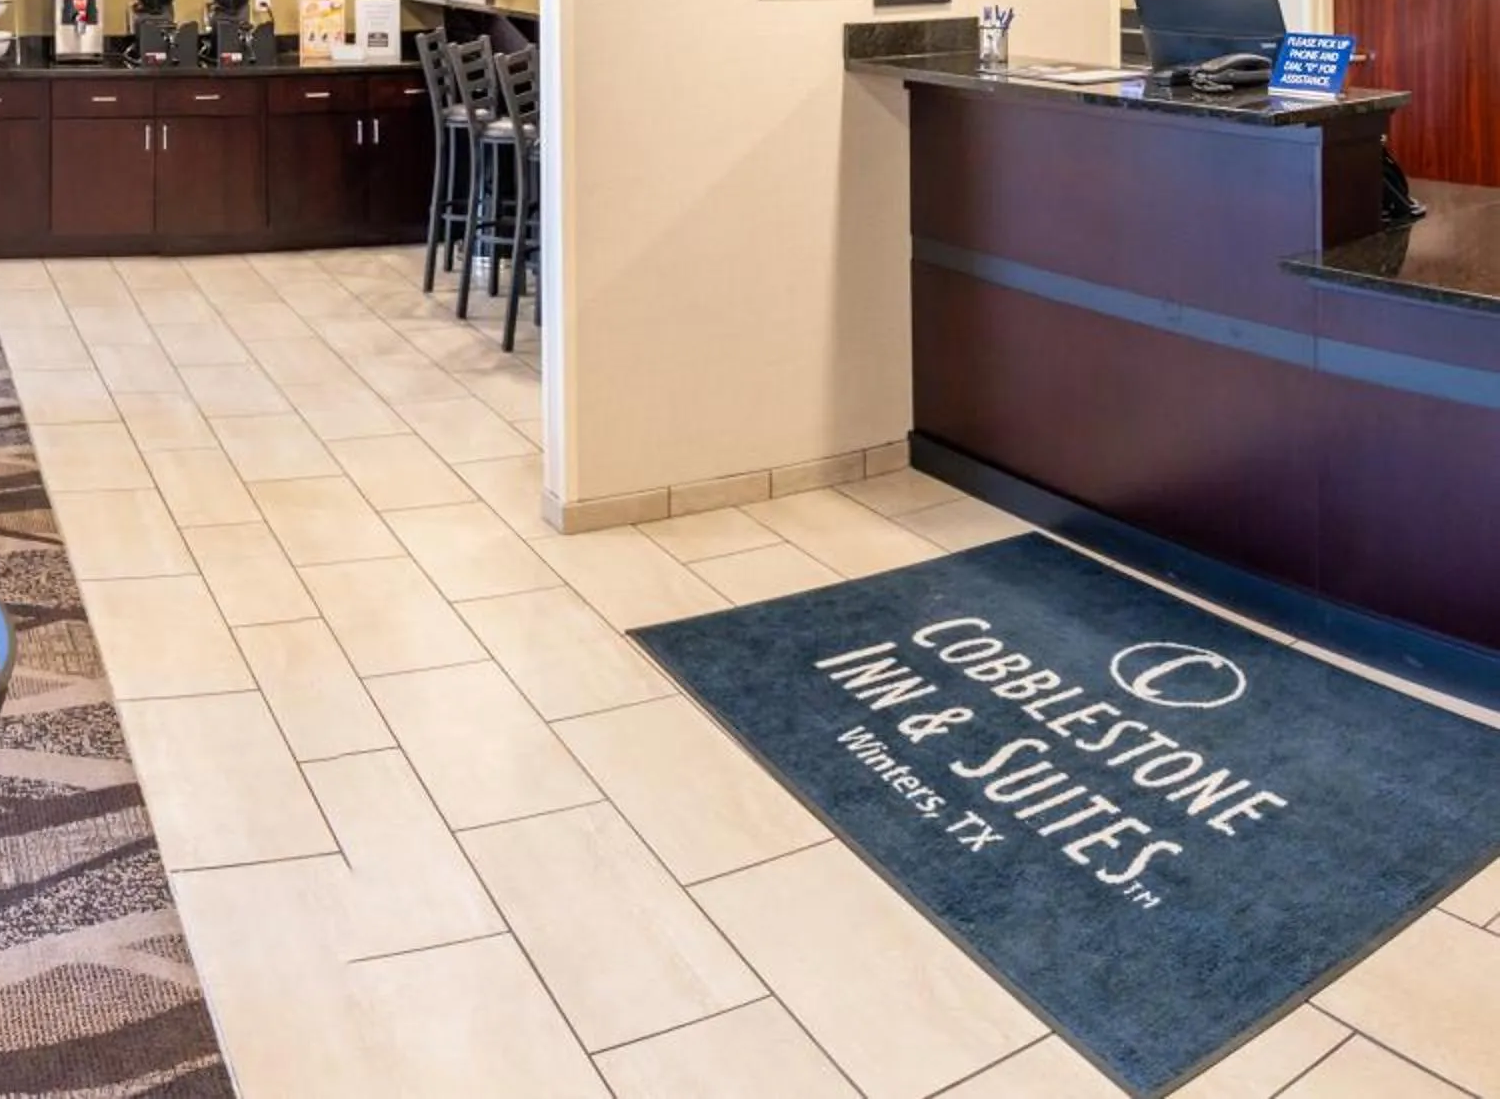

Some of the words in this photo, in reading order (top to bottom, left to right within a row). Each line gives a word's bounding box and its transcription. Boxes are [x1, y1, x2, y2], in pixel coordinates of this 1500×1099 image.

[1284, 61, 1303, 72] DIAL
[1319, 64, 1337, 74] FOR
[1287, 37, 1317, 48] PLEASE
[1317, 38, 1336, 49] PICK
[1337, 40, 1350, 50] UP
[1289, 49, 1318, 60] PHONE
[1319, 51, 1339, 62] AND
[911, 617, 1287, 836] COBBLESTONE
[814, 642, 938, 710] INN
[898, 707, 973, 743] &
[950, 738, 1184, 885] SUITES
[837, 726, 946, 820] Winters,
[946, 810, 1004, 852] TX
